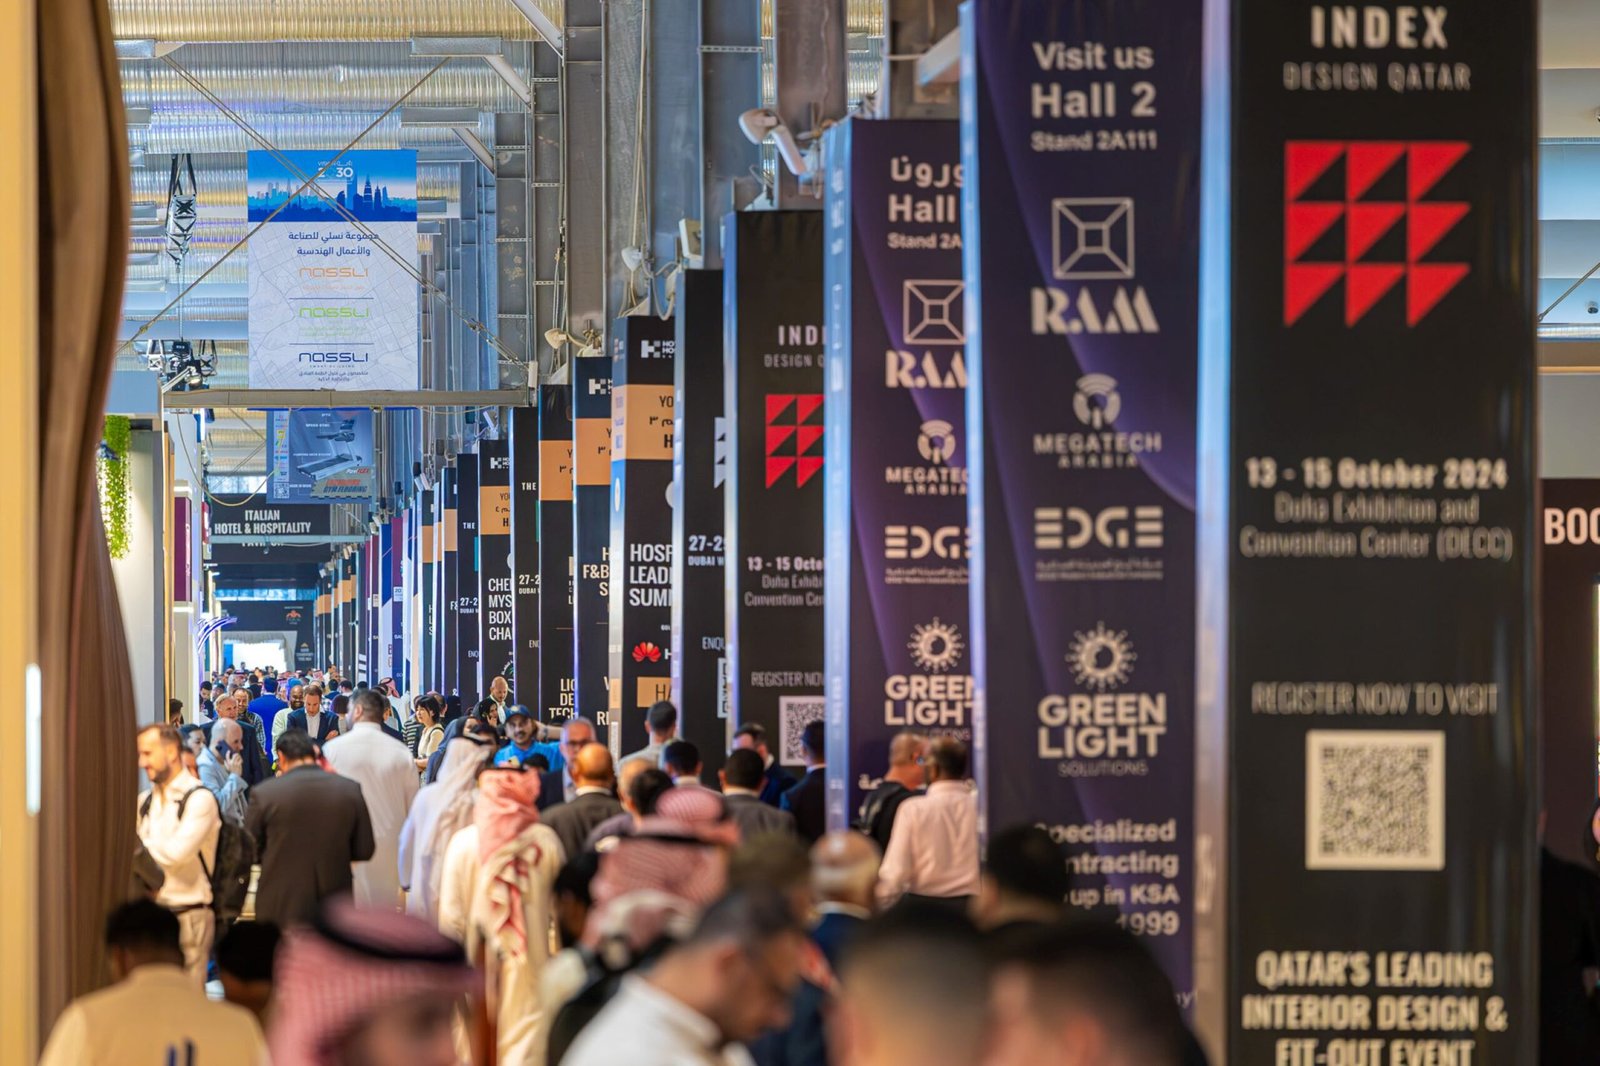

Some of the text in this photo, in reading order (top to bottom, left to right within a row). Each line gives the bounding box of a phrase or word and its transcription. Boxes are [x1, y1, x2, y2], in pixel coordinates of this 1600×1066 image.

[1311, 5, 1449, 49] INDEX
[1033, 41, 1154, 70] Visit us
[1283, 62, 1472, 93] DESIGN QATAR
[1031, 81, 1156, 119] Hall 2
[1031, 130, 1157, 151] Stand 2A111
[888, 194, 955, 223] Hall
[297, 246, 334, 257] الهندسية
[887, 233, 937, 249] Stand
[1030, 286, 1159, 334] RAM
[764, 354, 812, 368] DESIGN
[1033, 433, 1162, 454] MEGATECH
[1058, 455, 1139, 468] ARABIA
[1246, 457, 1277, 489] 13
[1302, 457, 1332, 489] 15
[1337, 457, 1438, 489] October
[1443, 457, 1508, 490] 2024
[521, 482, 537, 491] THE
[245, 509, 280, 521] ITALIAN
[1274, 491, 1480, 524] Doha Exhibition and
[214, 522, 311, 534] HOTEL & HOSPITALITY
[1035, 505, 1163, 549] EDGE
[688, 535, 726, 552] 27-2
[1240, 525, 1513, 562] Convention Center (DECC)
[688, 555, 715, 566] DUBAI
[747, 556, 764, 571] 13
[775, 556, 791, 571] 15
[762, 574, 789, 589] Doha
[744, 591, 804, 607] Convention
[489, 611, 511, 624] BOX
[751, 671, 803, 687] REGISTER
[1251, 682, 1498, 716] REGISTER NOW TO VISIT
[1038, 694, 1167, 727] GREEN
[1038, 727, 1166, 759] LIGHT
[1057, 760, 1149, 777] SOLUTIONS
[1034, 818, 1177, 843] pecialized
[1104, 884, 1126, 905] in
[1130, 883, 1180, 905] KSA
[1256, 951, 1493, 990] QATAR'S LEADING
[1241, 995, 1508, 1031] INTERIOR DESIGN &
